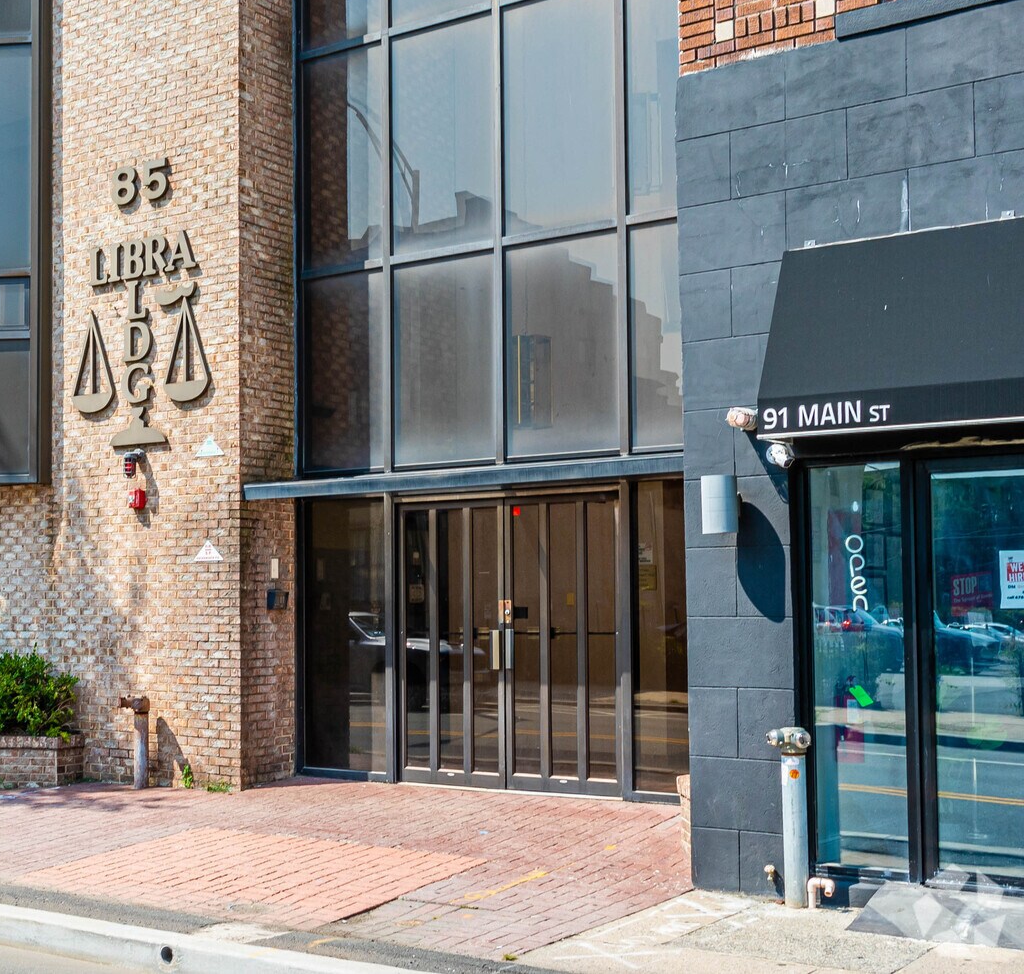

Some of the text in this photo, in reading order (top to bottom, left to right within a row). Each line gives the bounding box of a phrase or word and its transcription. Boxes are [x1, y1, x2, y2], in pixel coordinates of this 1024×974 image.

[111, 157, 169, 206] 85
[89, 230, 197, 287] LIBRA
[763, 400, 890, 430] 91 MAIN ST
[953, 576, 977, 596] STOP
